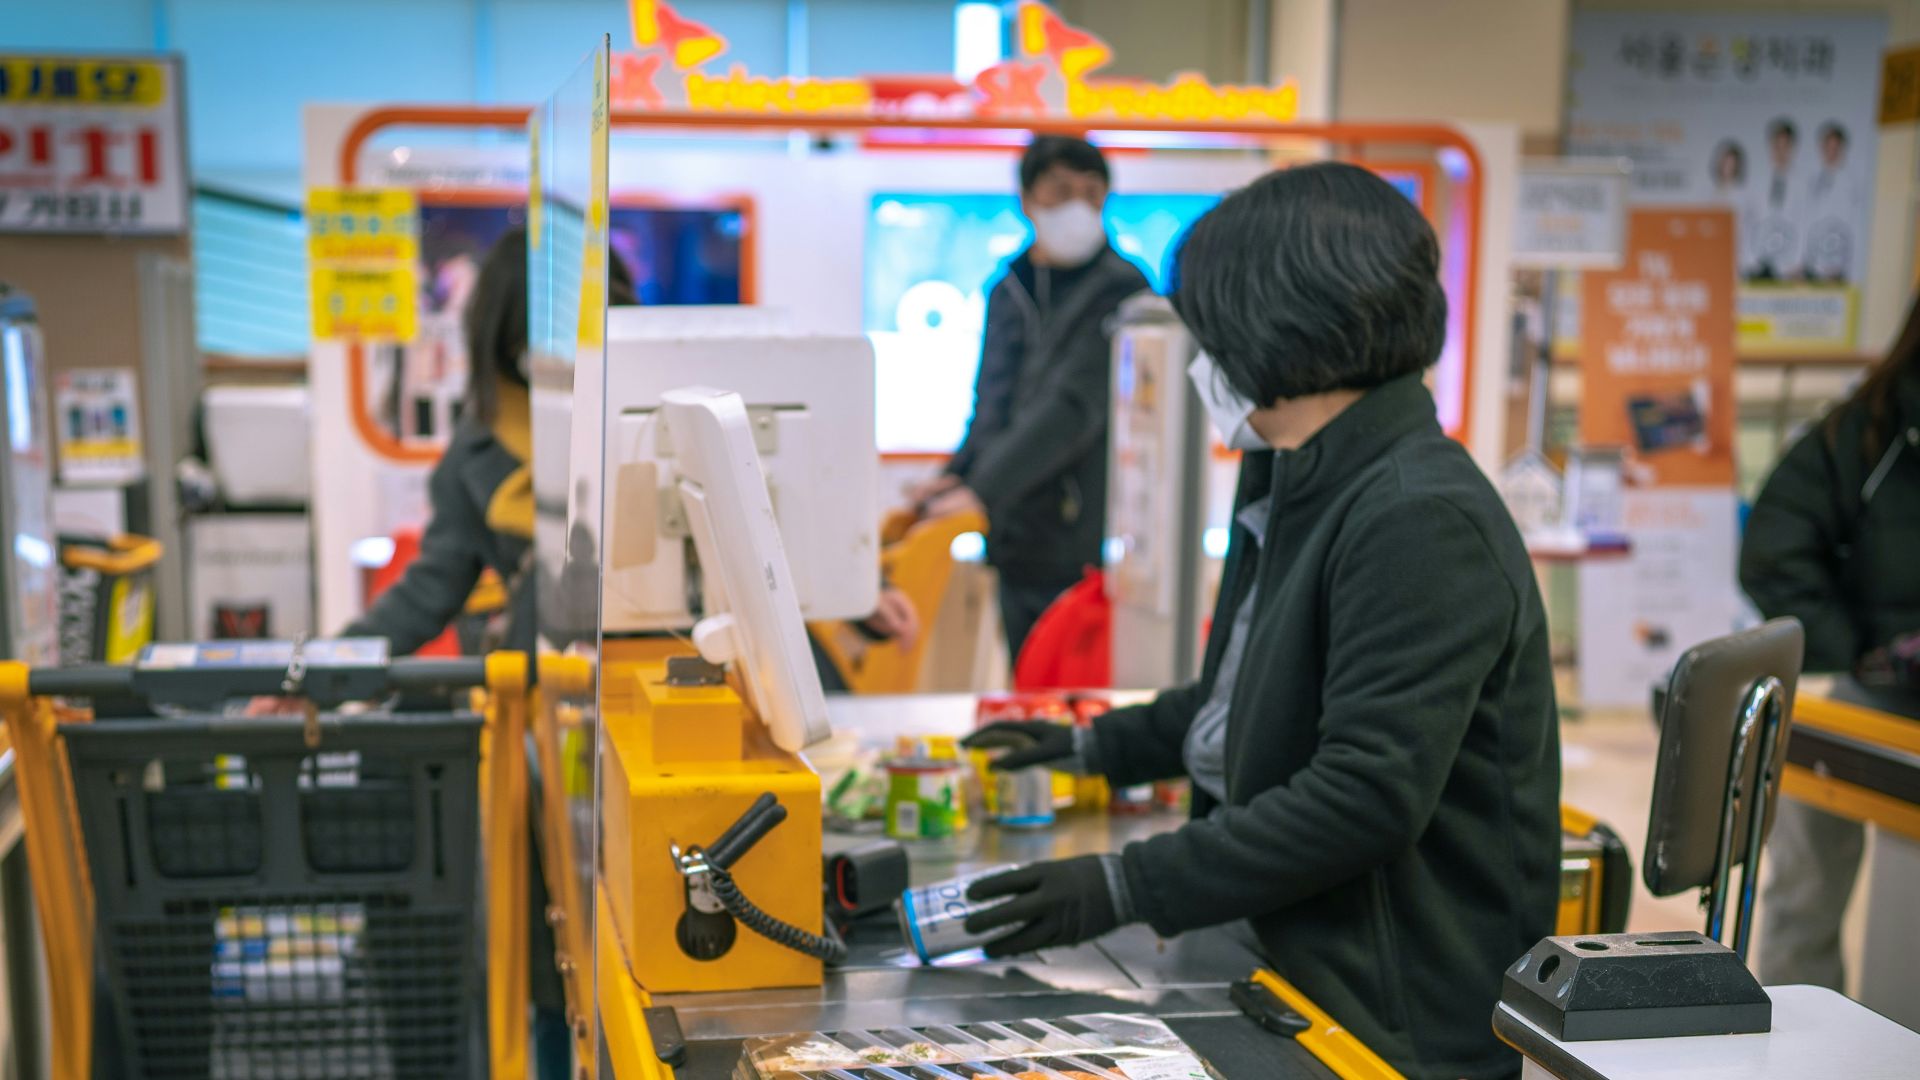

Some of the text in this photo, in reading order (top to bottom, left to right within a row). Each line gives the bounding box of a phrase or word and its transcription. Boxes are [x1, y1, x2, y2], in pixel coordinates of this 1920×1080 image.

[686, 65, 872, 112] telecom
[972, 63, 1048, 117] SK
[1067, 73, 1299, 121] broadband
